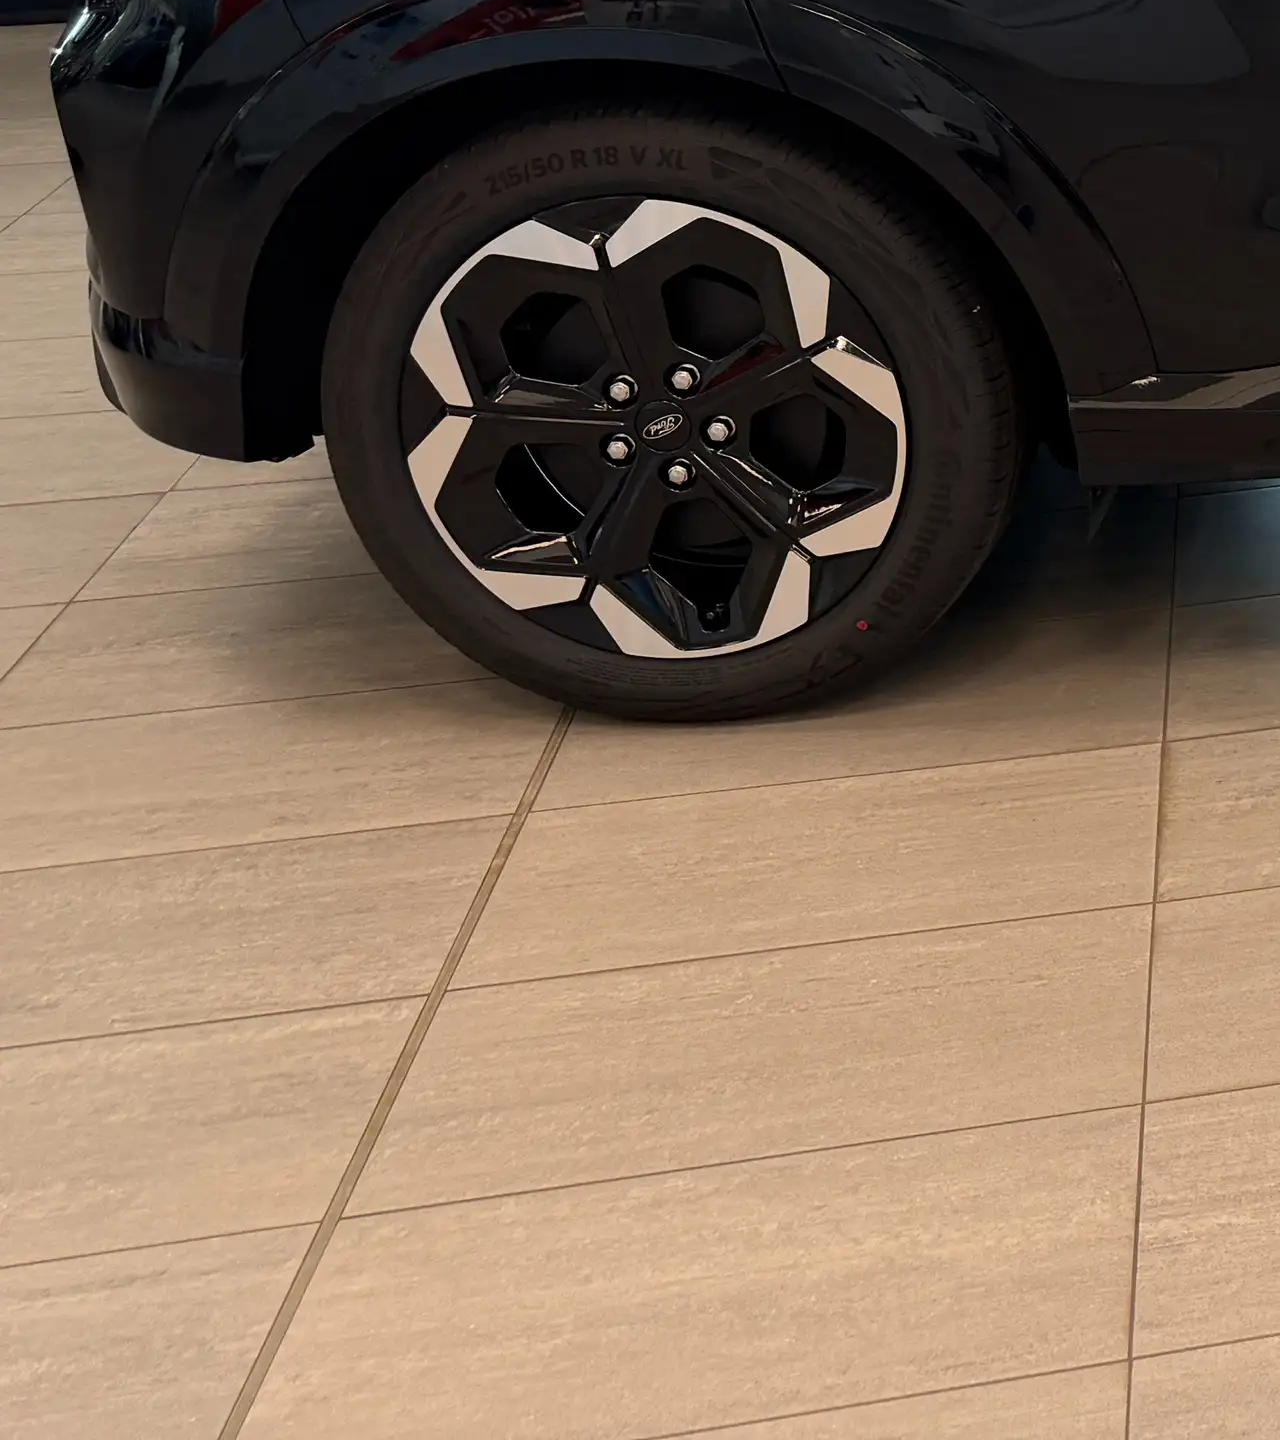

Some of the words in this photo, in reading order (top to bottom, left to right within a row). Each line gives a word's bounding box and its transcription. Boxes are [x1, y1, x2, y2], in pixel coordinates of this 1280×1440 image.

[484, 153, 565, 196] 215/50
[570, 148, 588, 170] R
[592, 146, 620, 167] 18
[629, 146, 648, 166] V
